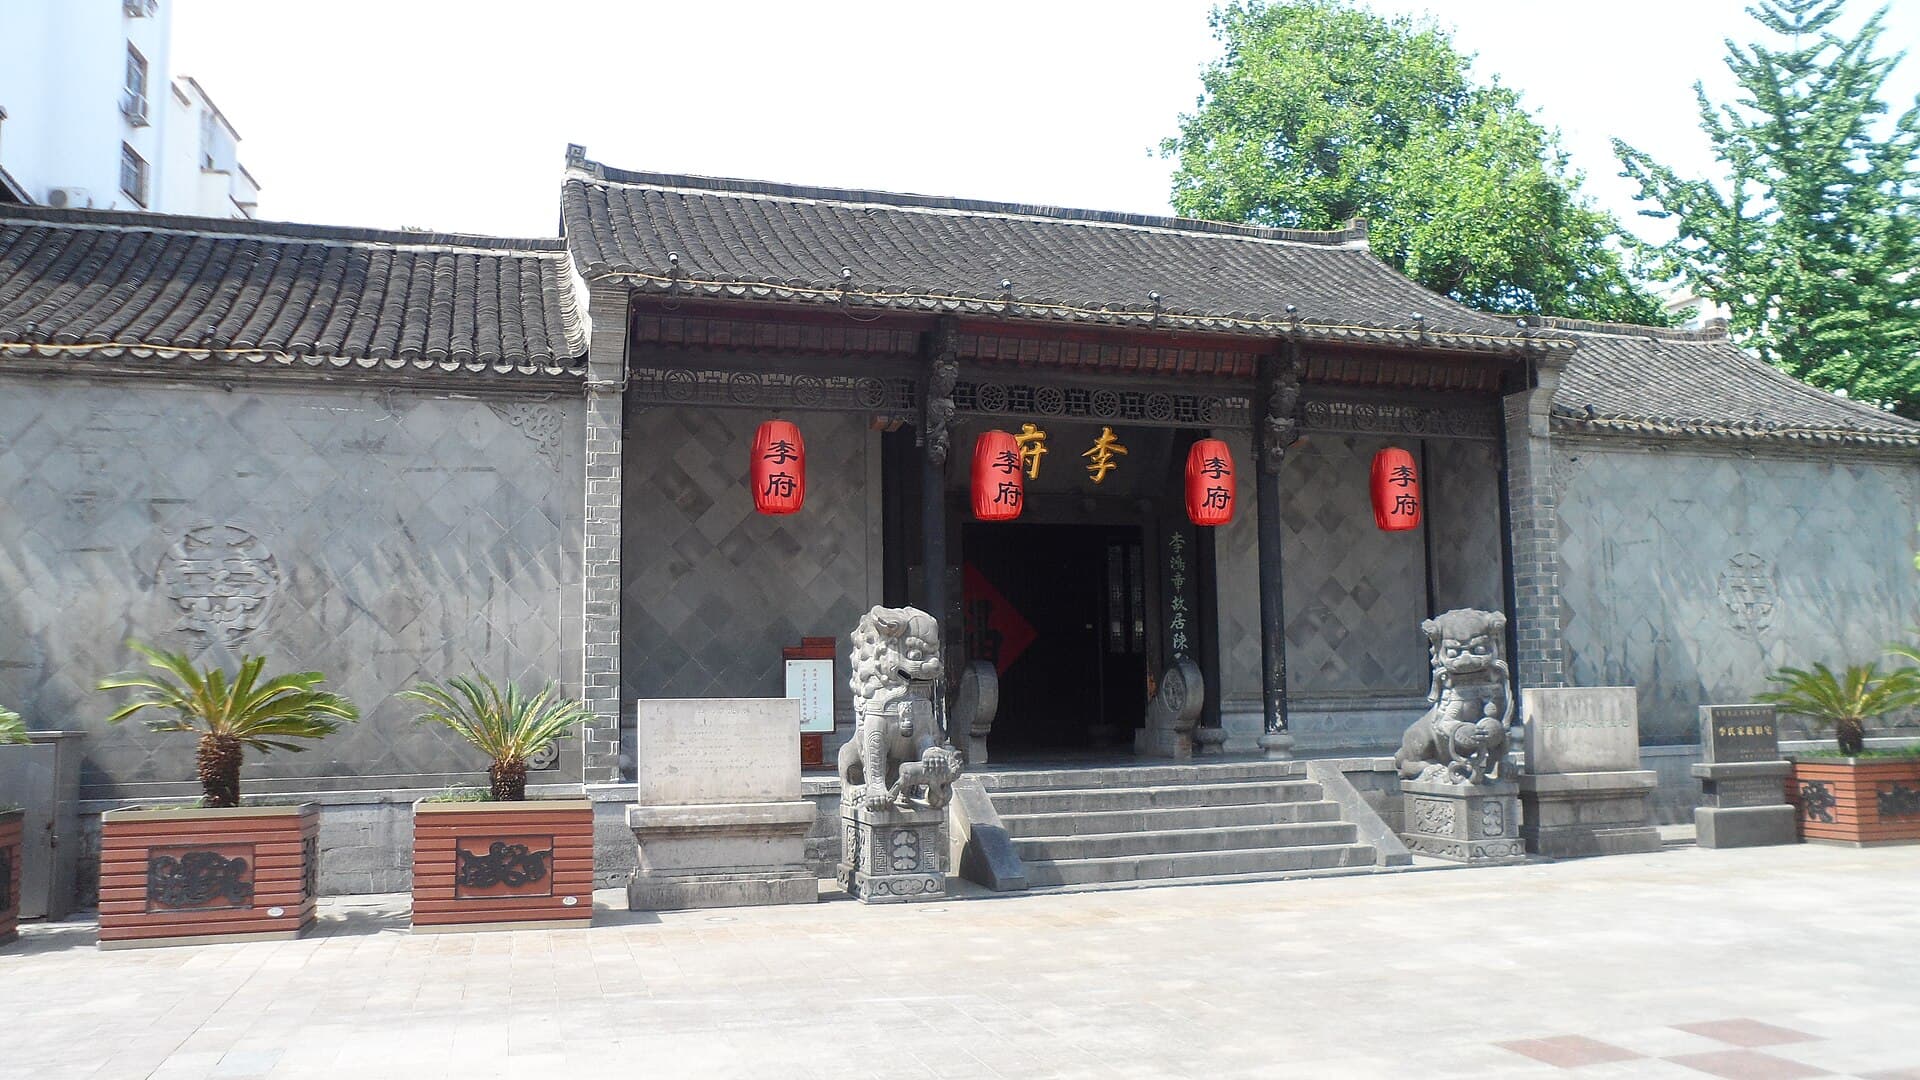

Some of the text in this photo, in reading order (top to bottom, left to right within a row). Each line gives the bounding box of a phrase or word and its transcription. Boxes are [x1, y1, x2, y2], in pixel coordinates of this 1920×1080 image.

[763, 440, 799, 498] 李府
[992, 450, 1021, 507] 李府
[1201, 457, 1231, 510] 李府
[1388, 465, 1417, 516] 李府
